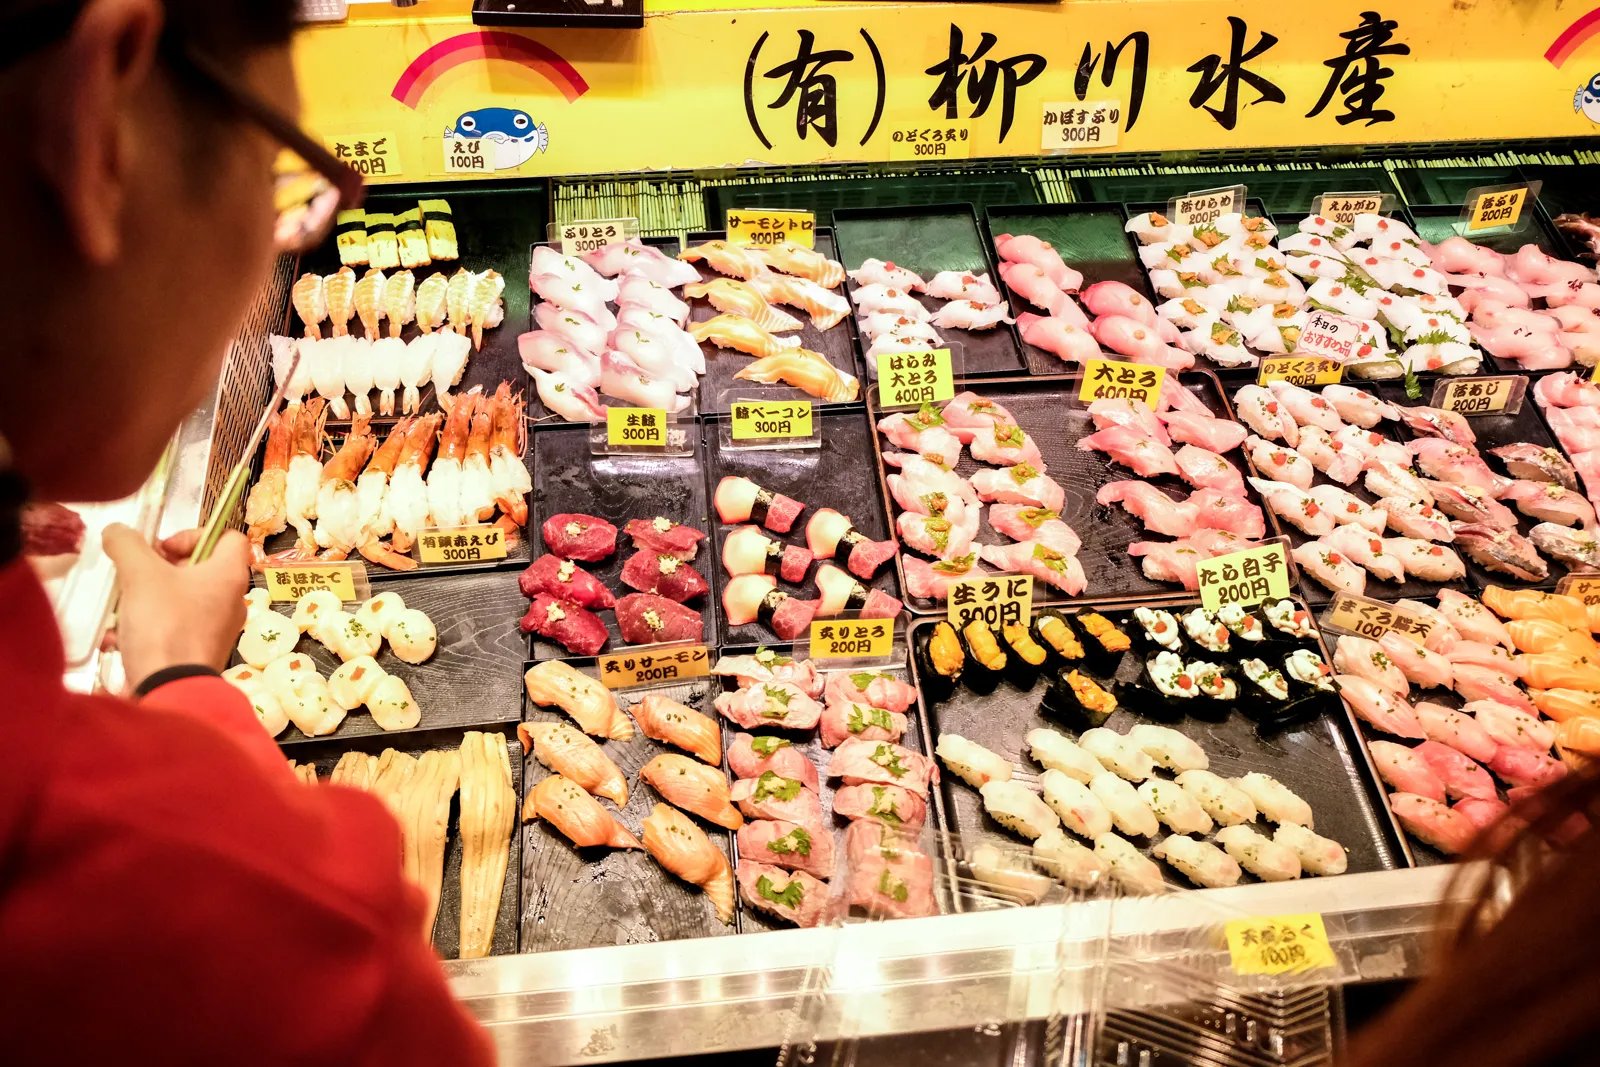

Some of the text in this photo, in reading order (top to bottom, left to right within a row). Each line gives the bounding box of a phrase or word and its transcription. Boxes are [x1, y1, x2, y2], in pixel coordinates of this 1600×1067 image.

[1043, 108, 1119, 125] かぼすぶり
[893, 128, 968, 142] のどぐろ炙り
[1062, 126, 1100, 141] 300円
[335, 138, 387, 158] たまご
[453, 141, 480, 153] えび
[914, 143, 946, 155] 300円
[450, 156, 484, 168] 100円
[1180, 195, 1231, 213] 活ひらめ
[1329, 200, 1376, 211] えんがわ
[1482, 193, 1518, 209] 活ぶり
[1189, 209, 1220, 225] 200円
[1335, 212, 1364, 223] 300
[1480, 206, 1512, 221] 200円
[729, 216, 812, 230] サーモントロ
[564, 226, 616, 239] ぶりとろ
[750, 232, 785, 244] 300円
[1312, 315, 1338, 333] 本日の
[1304, 332, 1352, 357] おすすめ品
[890, 353, 936, 370] はらみ
[1264, 360, 1341, 374] のどぐろ炙り
[890, 370, 937, 387] 大とろ
[1093, 363, 1156, 387] 大とろ
[895, 386, 934, 403] 400円
[1453, 381, 1499, 398] 活あじ
[1451, 397, 1491, 411] 200円
[627, 413, 656, 427] 生鯨
[736, 407, 809, 419] 鯨ベーコン
[622, 428, 659, 440] 300円
[755, 420, 791, 433] 300円
[422, 533, 498, 548] 有頭赤えび
[443, 547, 480, 560] 300円
[1200, 552, 1282, 586] たら白子
[276, 572, 341, 584] 活ほたて
[953, 578, 1028, 605] 生うに
[1218, 577, 1270, 604] 200円
[1340, 600, 1431, 638] まぐろ脳天
[819, 625, 885, 640] 炙りとろ
[1355, 620, 1399, 637] 100
[830, 639, 871, 653] 200円
[605, 650, 706, 673] 炙りサーモン
[636, 665, 677, 681] 200円
